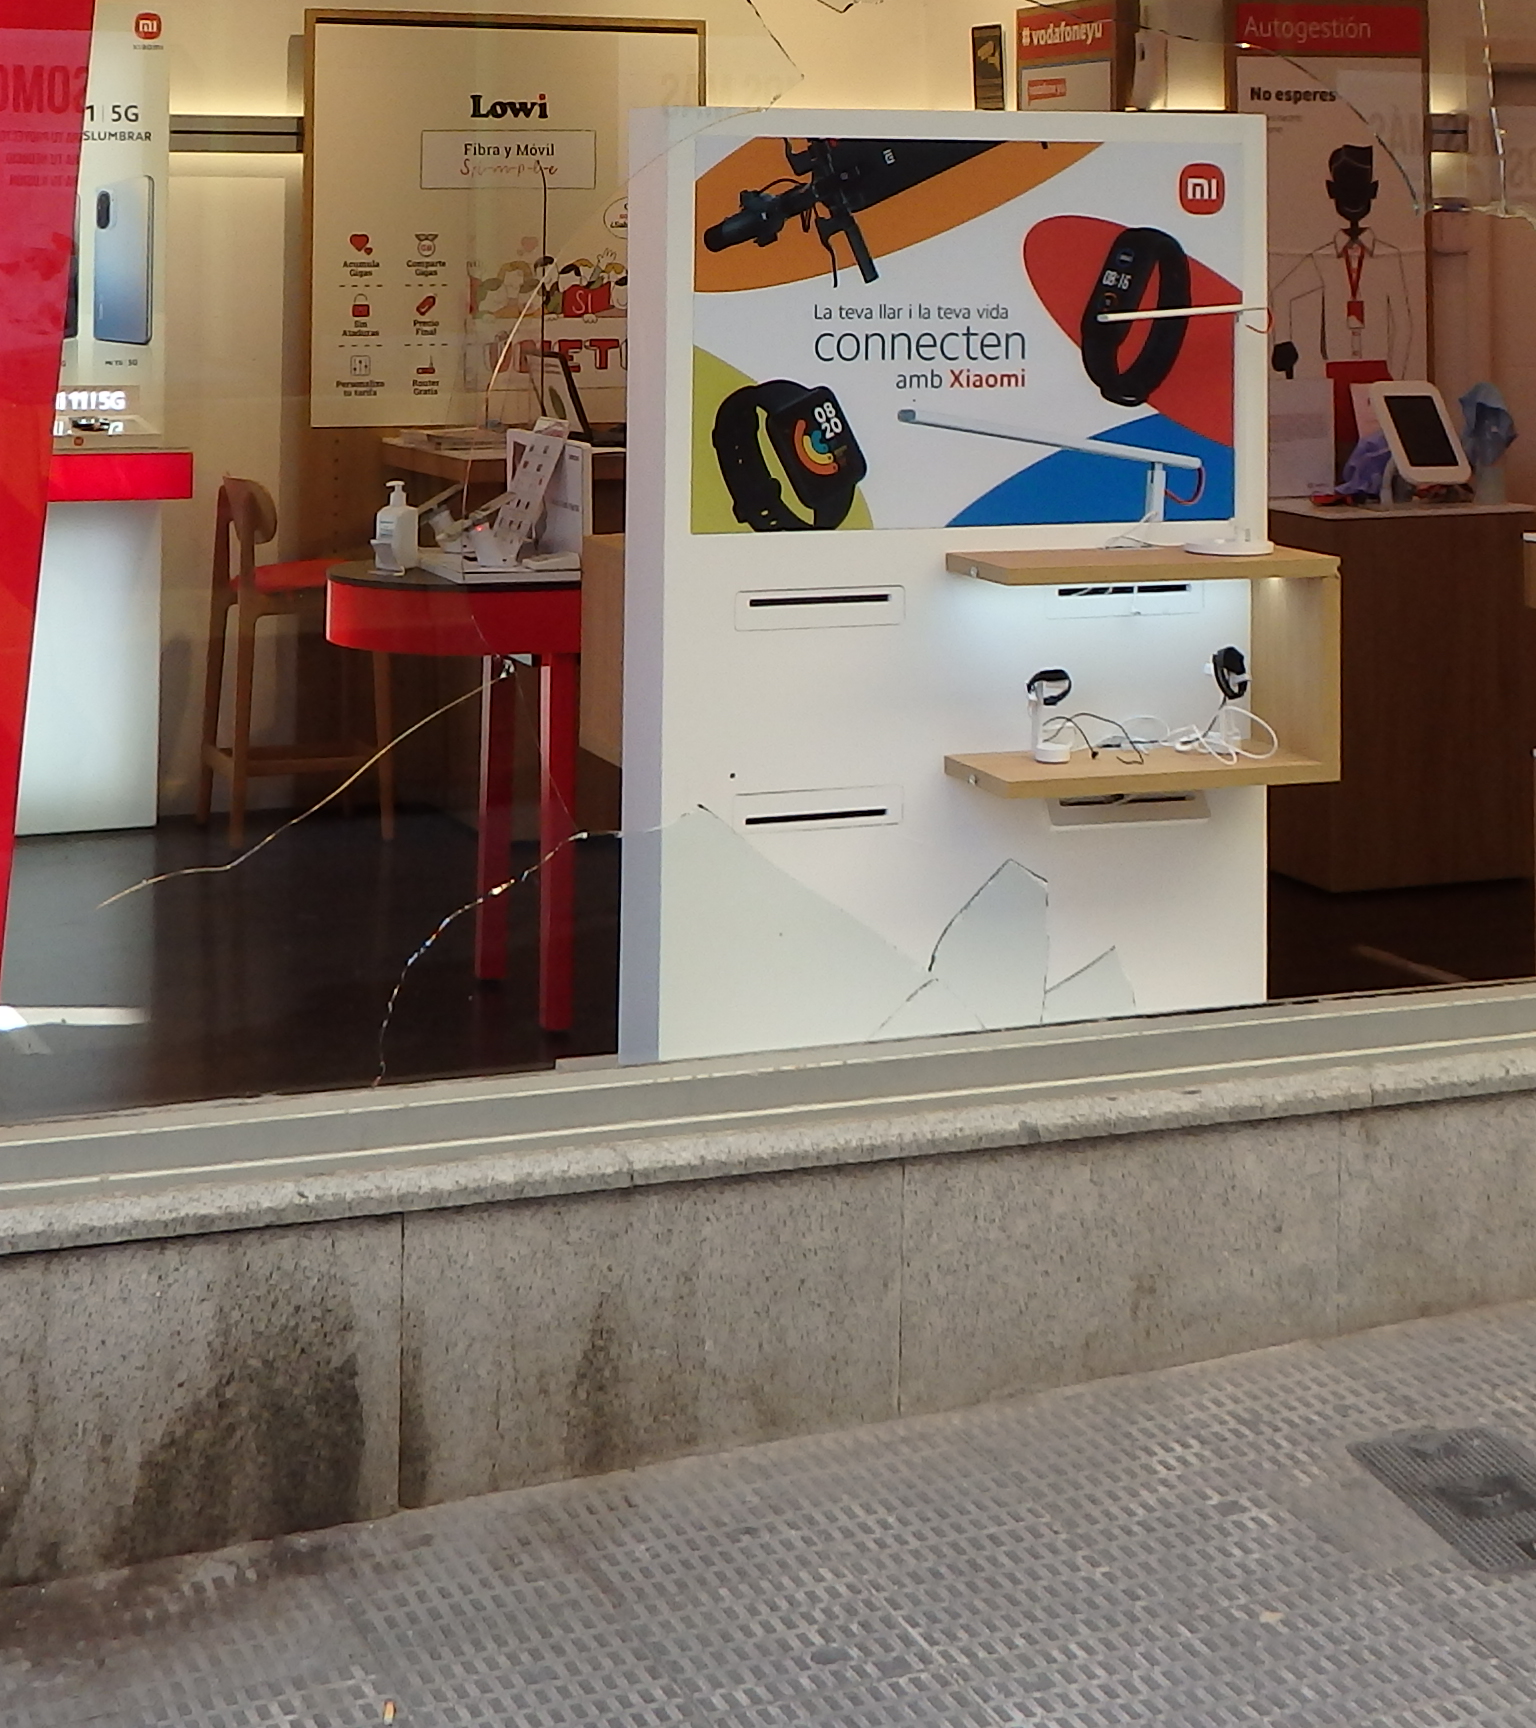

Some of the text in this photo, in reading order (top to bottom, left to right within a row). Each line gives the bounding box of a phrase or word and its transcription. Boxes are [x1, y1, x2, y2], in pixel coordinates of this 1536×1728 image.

[1021, 21, 1103, 47] #vodafoneyu
[1244, 15, 1371, 44] Autogestión
[1250, 87, 1337, 105] No esperes
[111, 105, 139, 122] 5G
[470, 93, 549, 119] Lowi
[83, 131, 152, 141] SLUMBRAR
[463, 143, 554, 159] Fibra y Móvil
[342, 260, 380, 269] Acumula
[406, 260, 447, 269] Comparte
[814, 304, 832, 320] La
[839, 304, 873, 320] teva
[879, 304, 902, 320] llar
[918, 304, 931, 320] la
[937, 305, 971, 320] teva
[977, 304, 1009, 320] vida
[341, 329, 380, 337] Ataduras
[415, 328, 437, 336] Final
[484, 330, 627, 374] ÚNET
[814, 326, 1026, 362] connecten
[335, 380, 385, 389] Personaliza
[412, 379, 439, 388] Router
[896, 368, 1026, 389] amb Xiaomi
[354, 388, 377, 397] tarifa
[413, 388, 438, 396] Gratis
[814, 401, 836, 423] 08
[821, 417, 843, 440] 20
